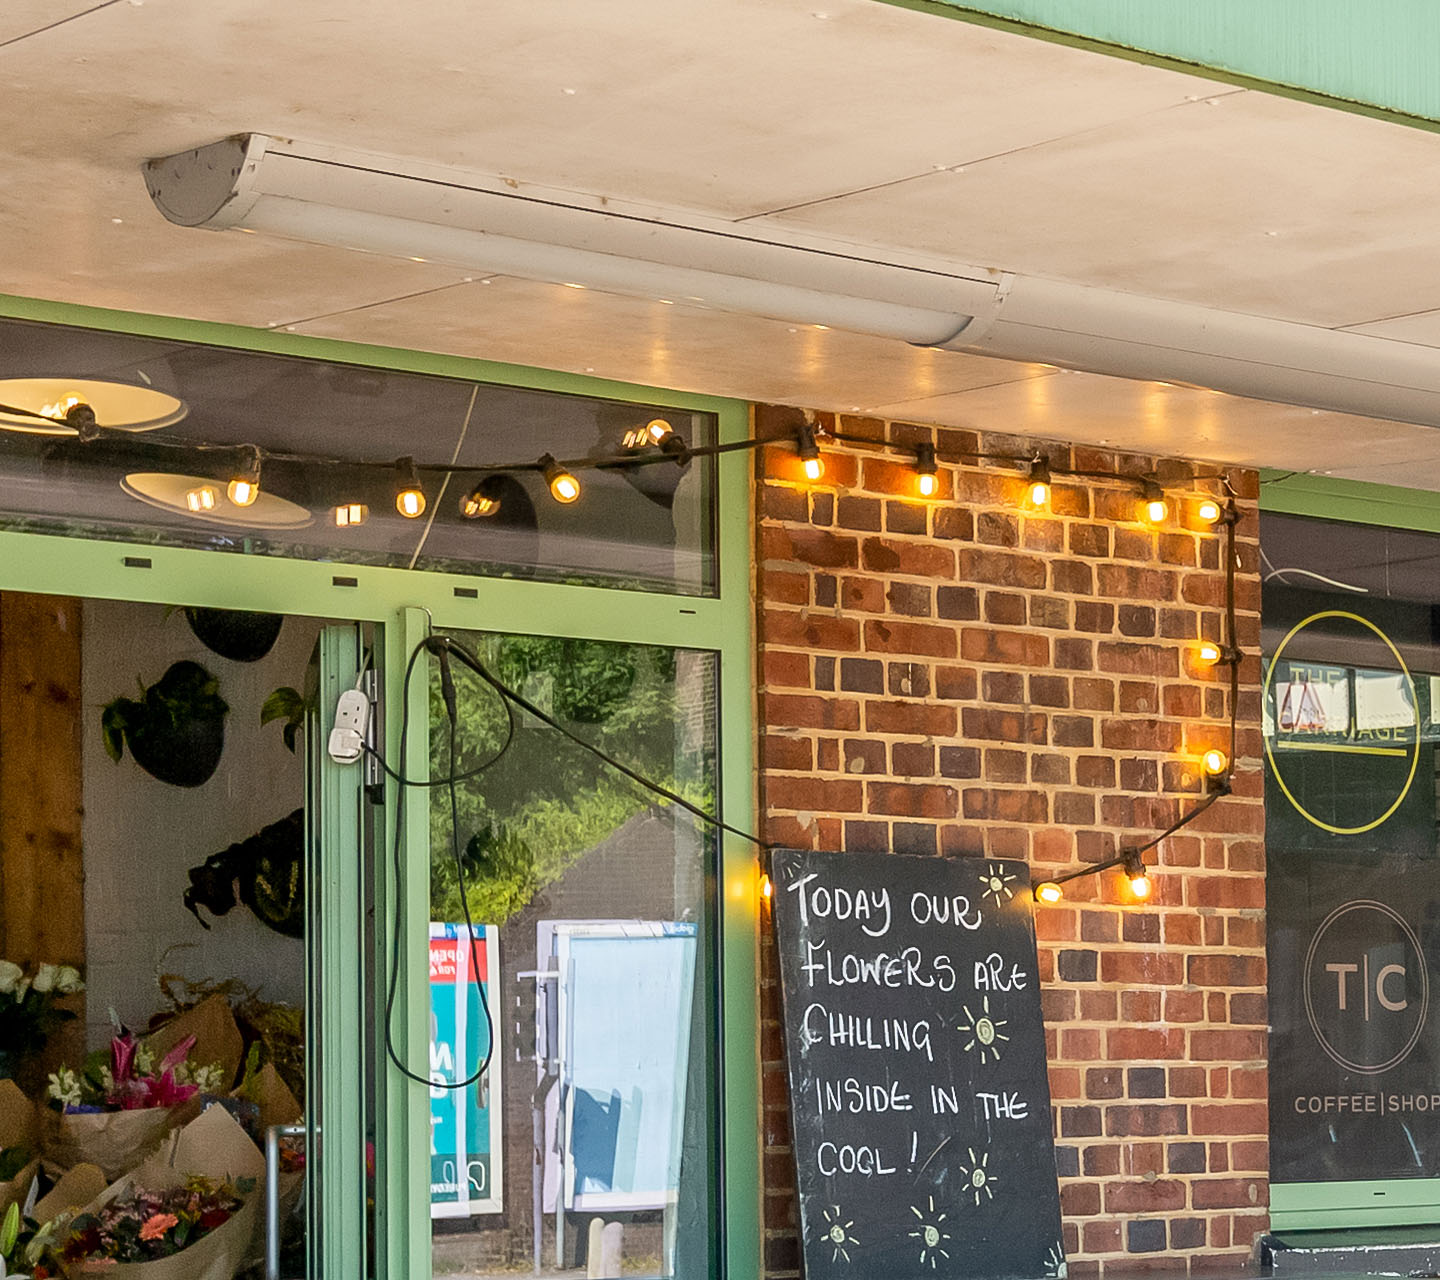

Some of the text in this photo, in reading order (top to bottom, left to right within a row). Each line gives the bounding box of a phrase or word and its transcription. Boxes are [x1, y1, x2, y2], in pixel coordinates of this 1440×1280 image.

[787, 873, 982, 937] TODAY OUR
[801, 938, 1027, 992] FLOWERS ARE
[803, 1003, 934, 1062] CHILLING
[816, 1077, 1028, 1120] INSIDE IN THE
